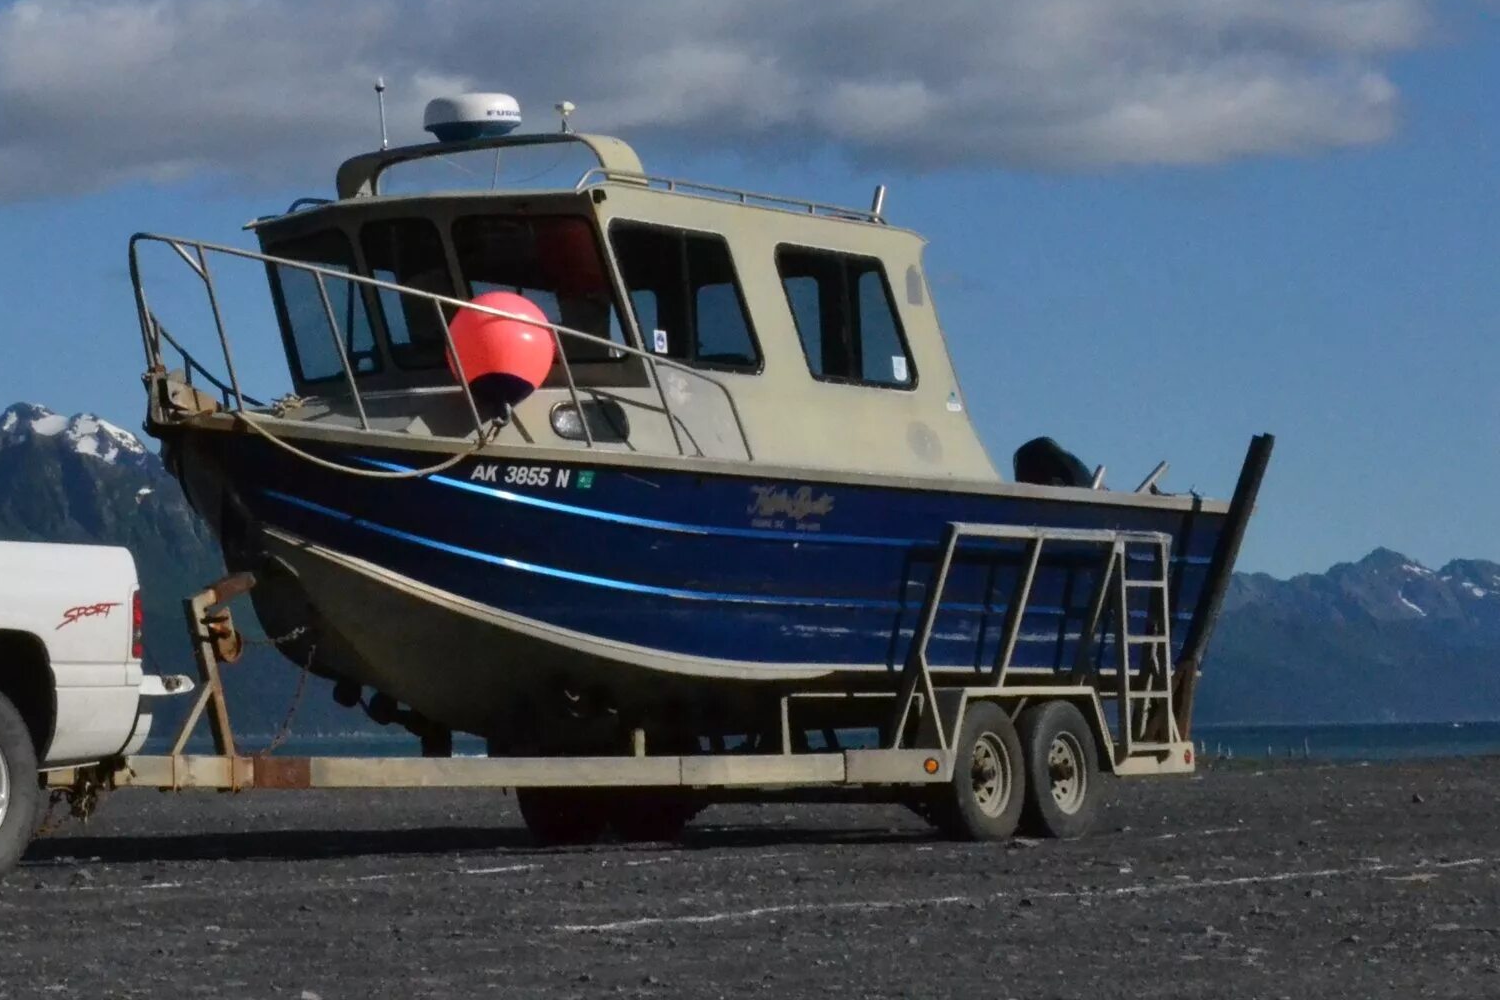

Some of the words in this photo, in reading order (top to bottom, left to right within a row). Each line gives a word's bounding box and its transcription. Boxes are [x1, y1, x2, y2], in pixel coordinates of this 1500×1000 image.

[470, 463, 498, 482] AK
[504, 465, 552, 486] 3855
[555, 468, 571, 488] N
[55, 602, 124, 630] SPORT
